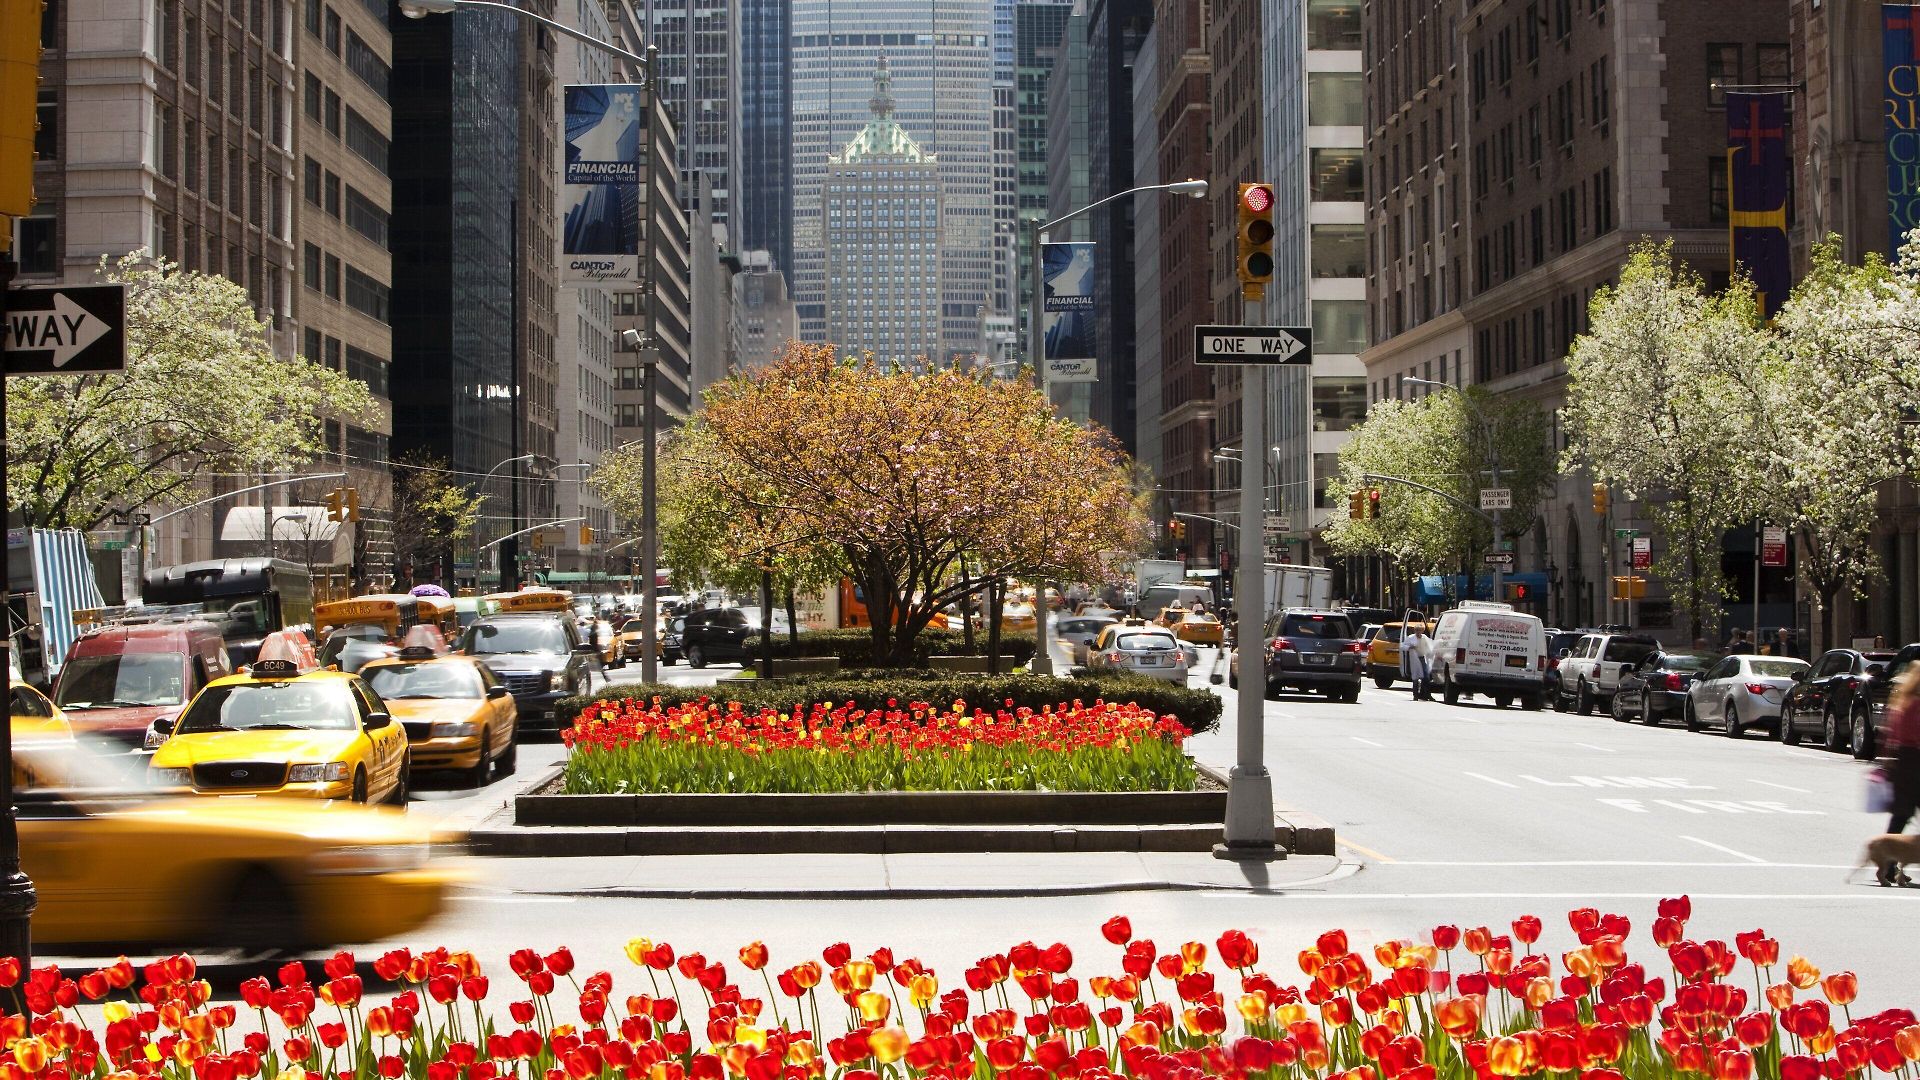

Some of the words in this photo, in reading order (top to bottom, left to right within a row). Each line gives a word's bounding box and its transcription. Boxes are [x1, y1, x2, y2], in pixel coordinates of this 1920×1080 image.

[568, 163, 636, 174] FINANCIAL
[568, 173, 594, 184] Capital
[595, 174, 602, 182] of
[603, 174, 614, 182] the
[615, 174, 636, 182] World
[570, 261, 615, 271] CANTOR
[582, 267, 631, 282] Fitzgerald
[1046, 297, 1093, 305] FINANCIAL
[12, 314, 86, 347] WAY
[1212, 338, 1245, 353] ONE
[1260, 339, 1294, 353] WAY
[1050, 363, 1081, 371] CANTOR
[1482, 490, 1509, 498] PASSENGER
[338, 606, 359, 616] SCHOOL
[360, 605, 371, 614] BUS
[264, 661, 285, 670] 6C49
